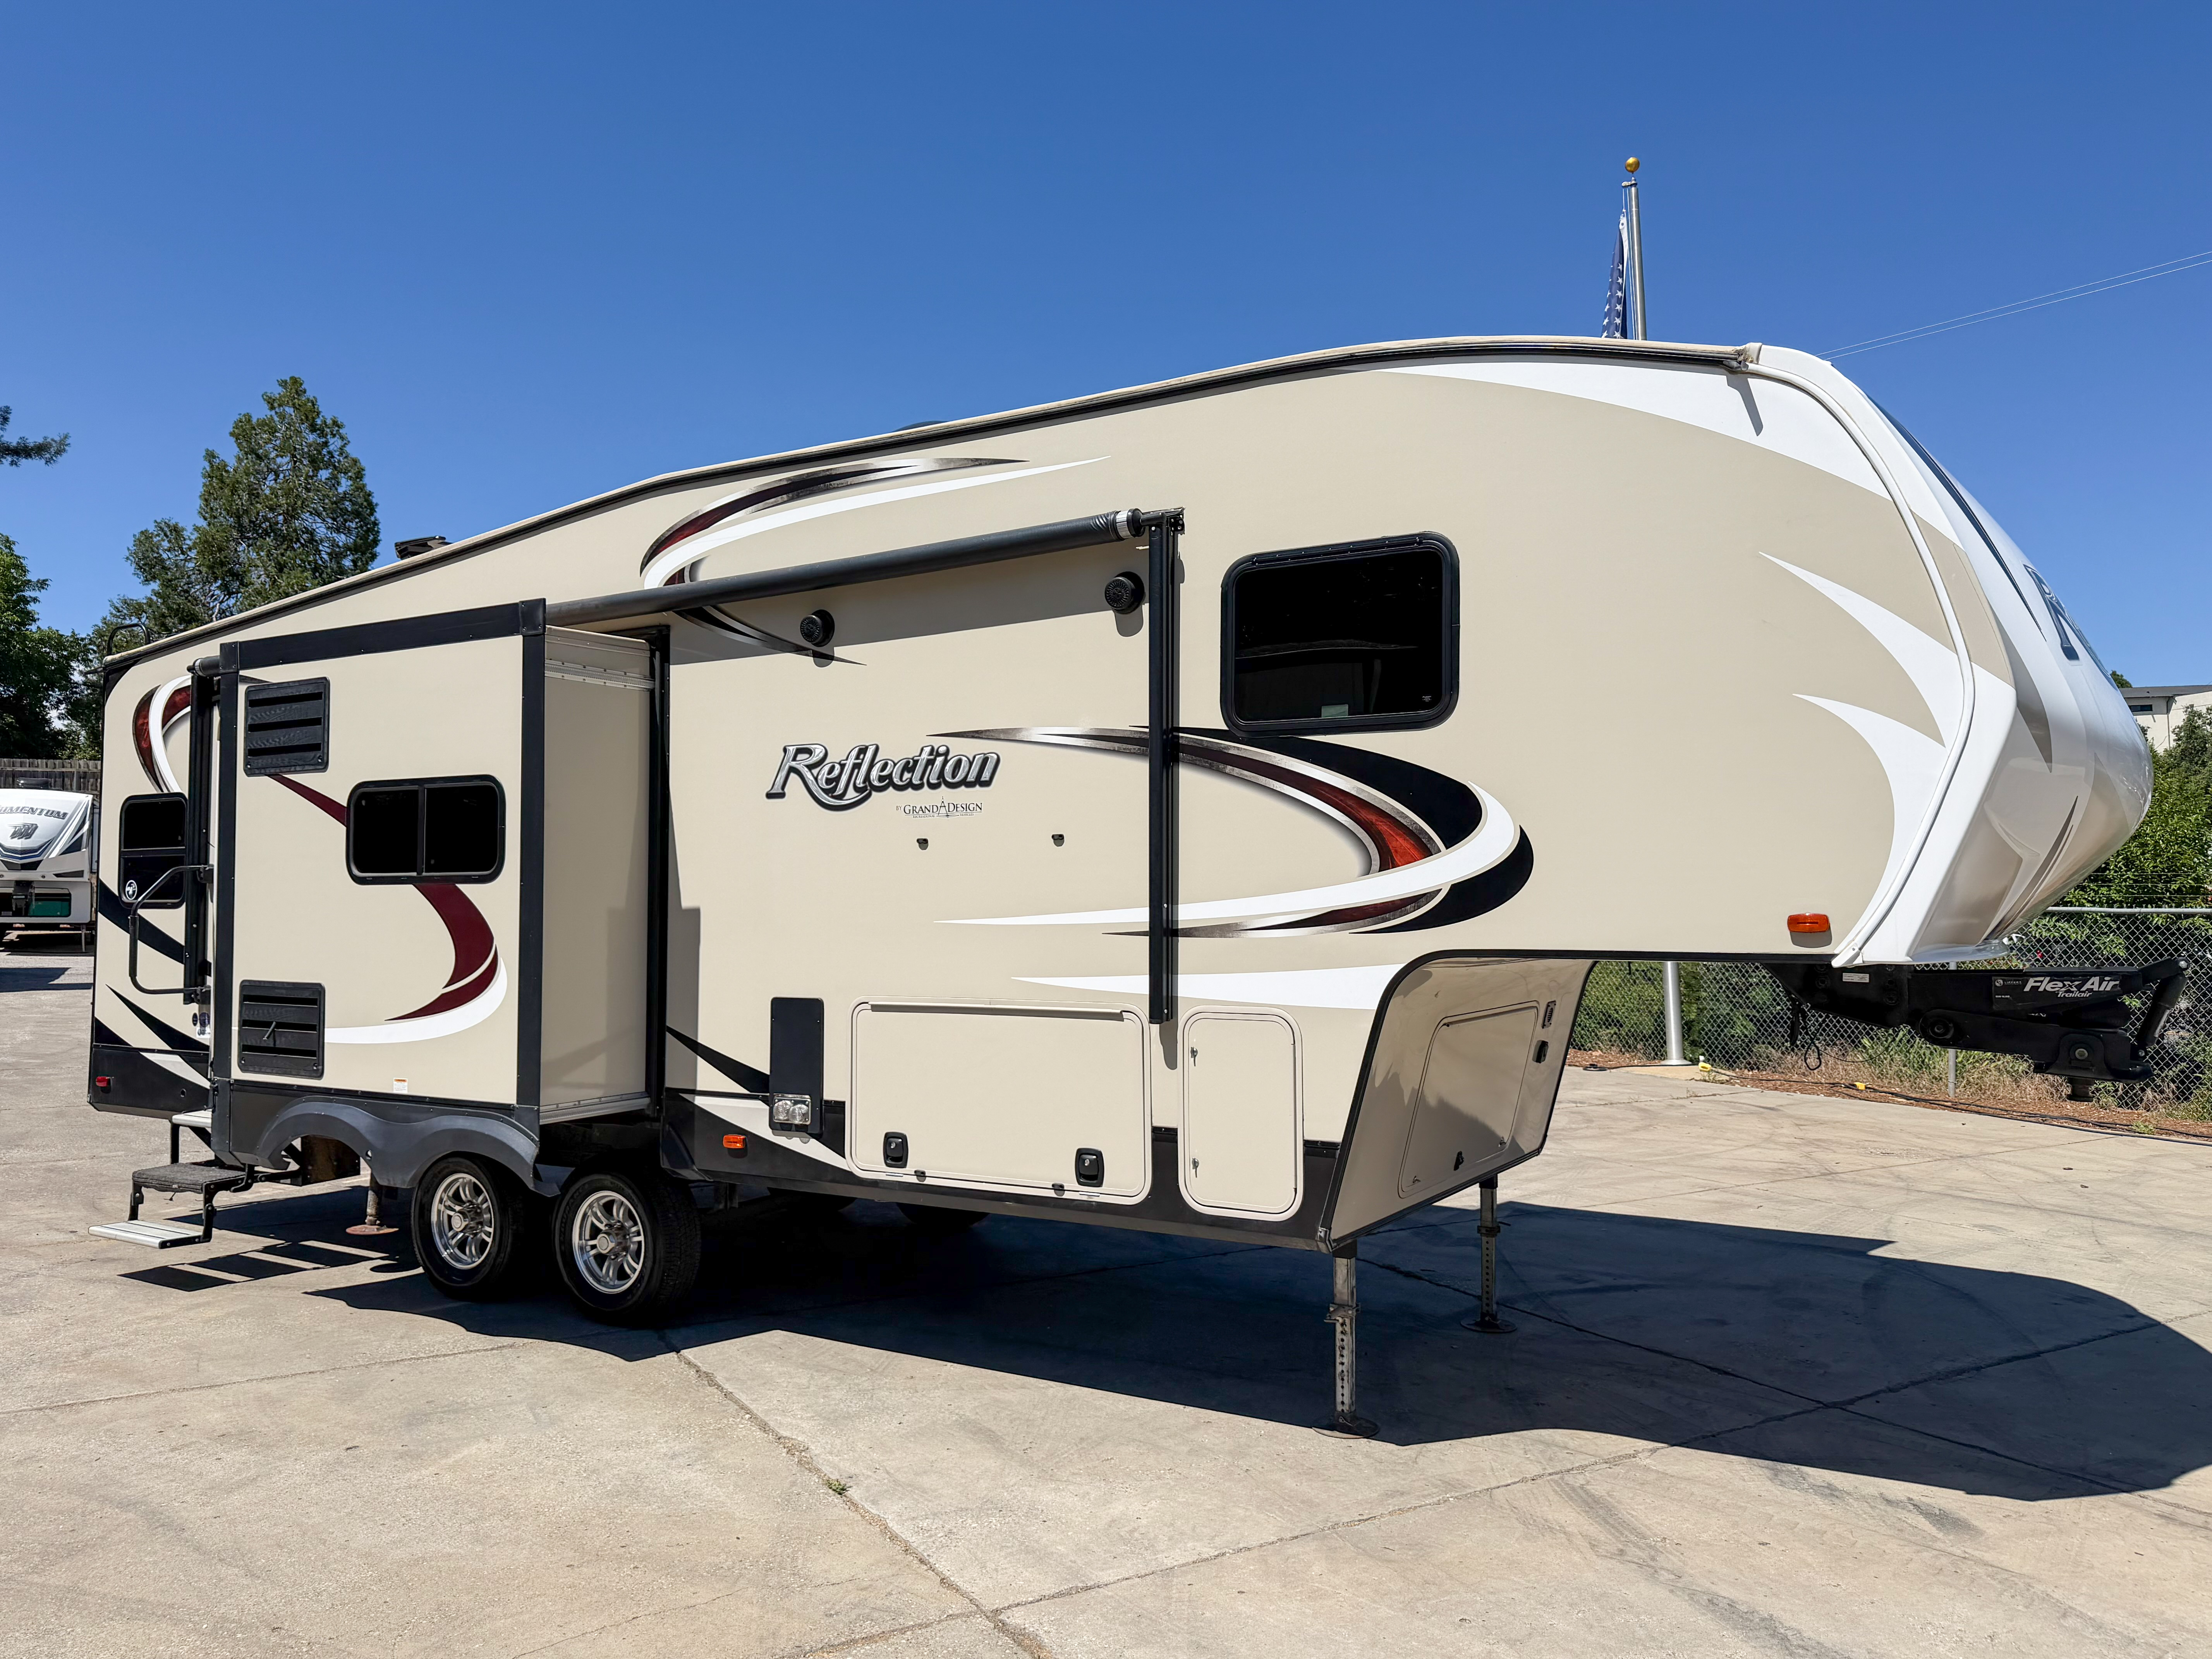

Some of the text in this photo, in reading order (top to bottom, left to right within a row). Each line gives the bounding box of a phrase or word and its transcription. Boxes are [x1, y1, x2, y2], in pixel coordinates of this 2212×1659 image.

[766, 743, 1001, 811] Reflection
[903, 804, 939, 814] GRAND
[947, 802, 982, 812] DESIGN
[2023, 976, 2119, 991] Flex Air
